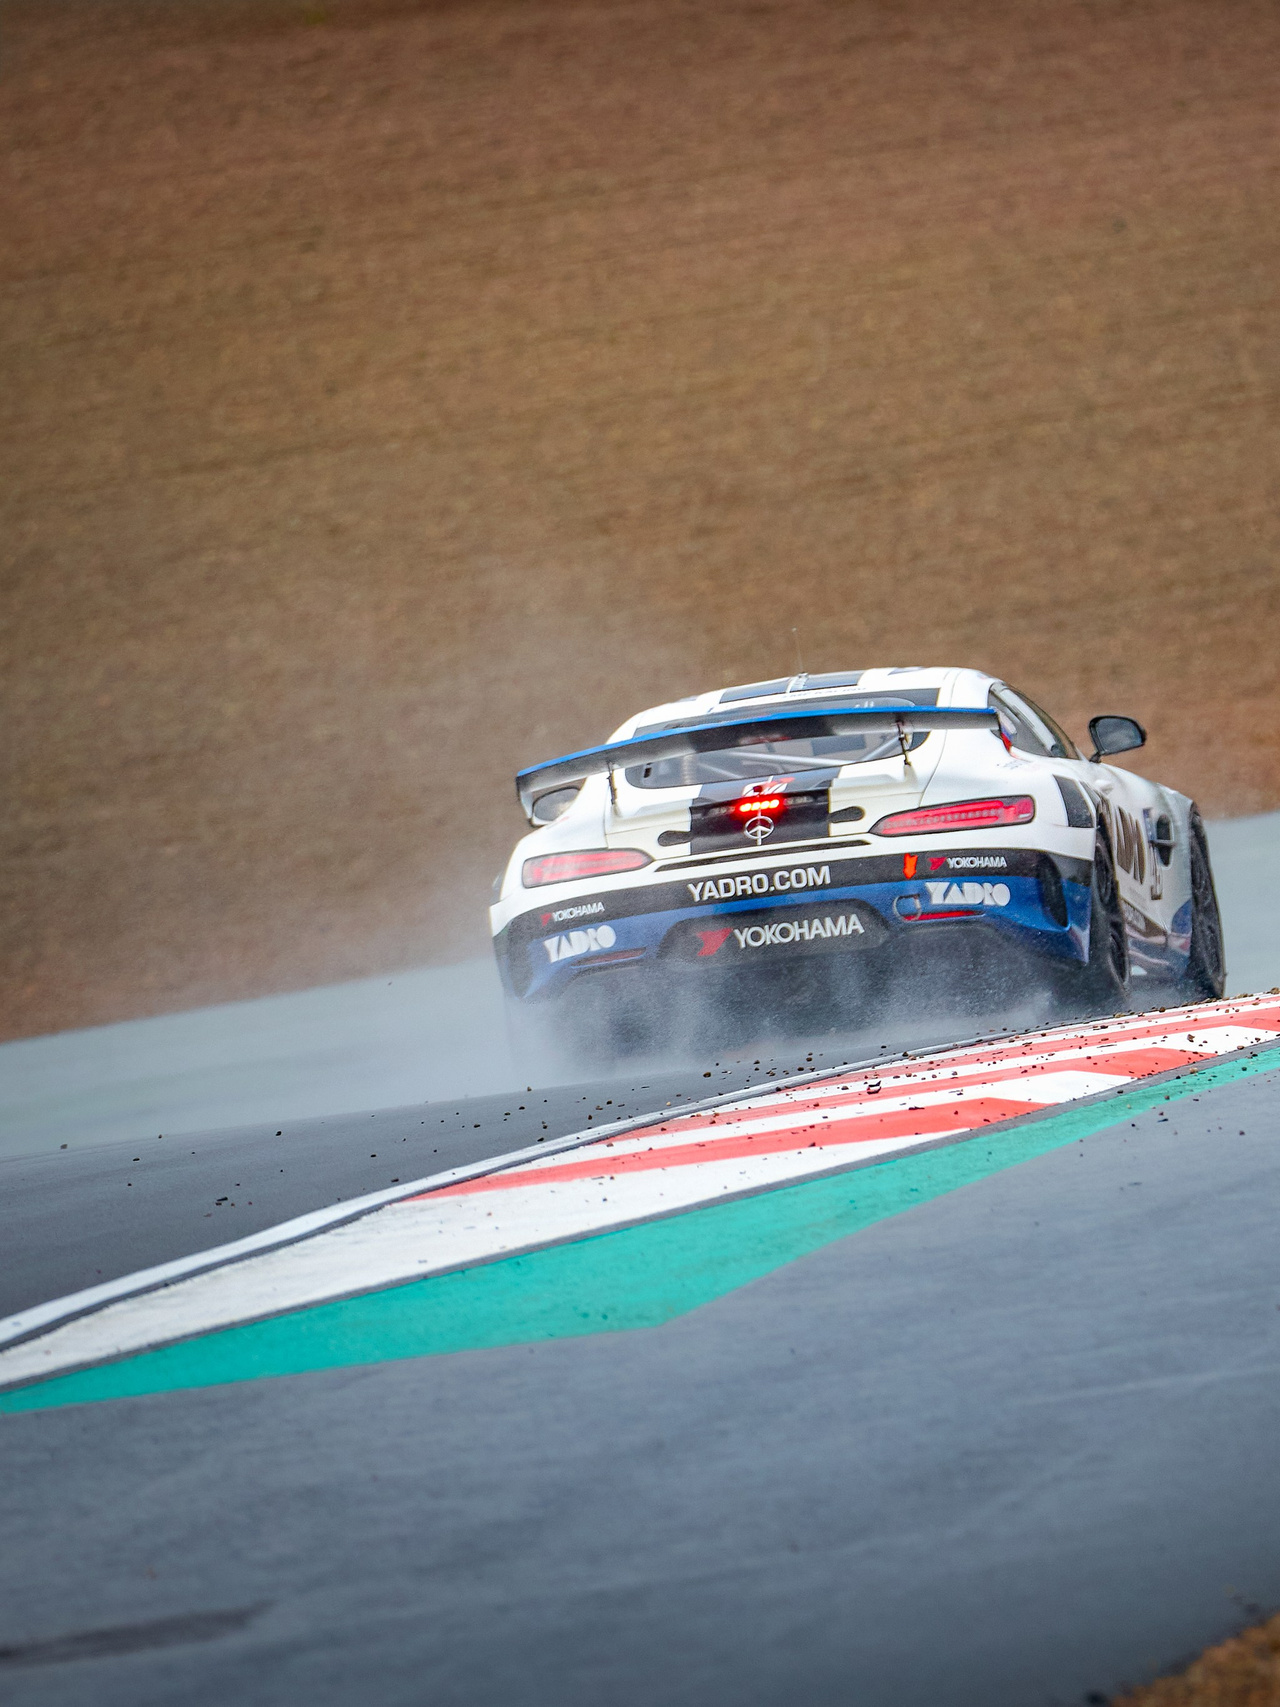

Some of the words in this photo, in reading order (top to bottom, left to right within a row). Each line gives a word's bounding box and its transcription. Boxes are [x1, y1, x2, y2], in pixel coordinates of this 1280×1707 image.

[946, 856, 1008, 869] YOKOHAMA
[687, 865, 831, 902] YADRO.COM
[925, 881, 1011, 907] YADRO
[552, 901, 605, 922] YOKOHAMA
[543, 924, 617, 963] YADRO
[733, 913, 865, 949] YOKOHAMA
